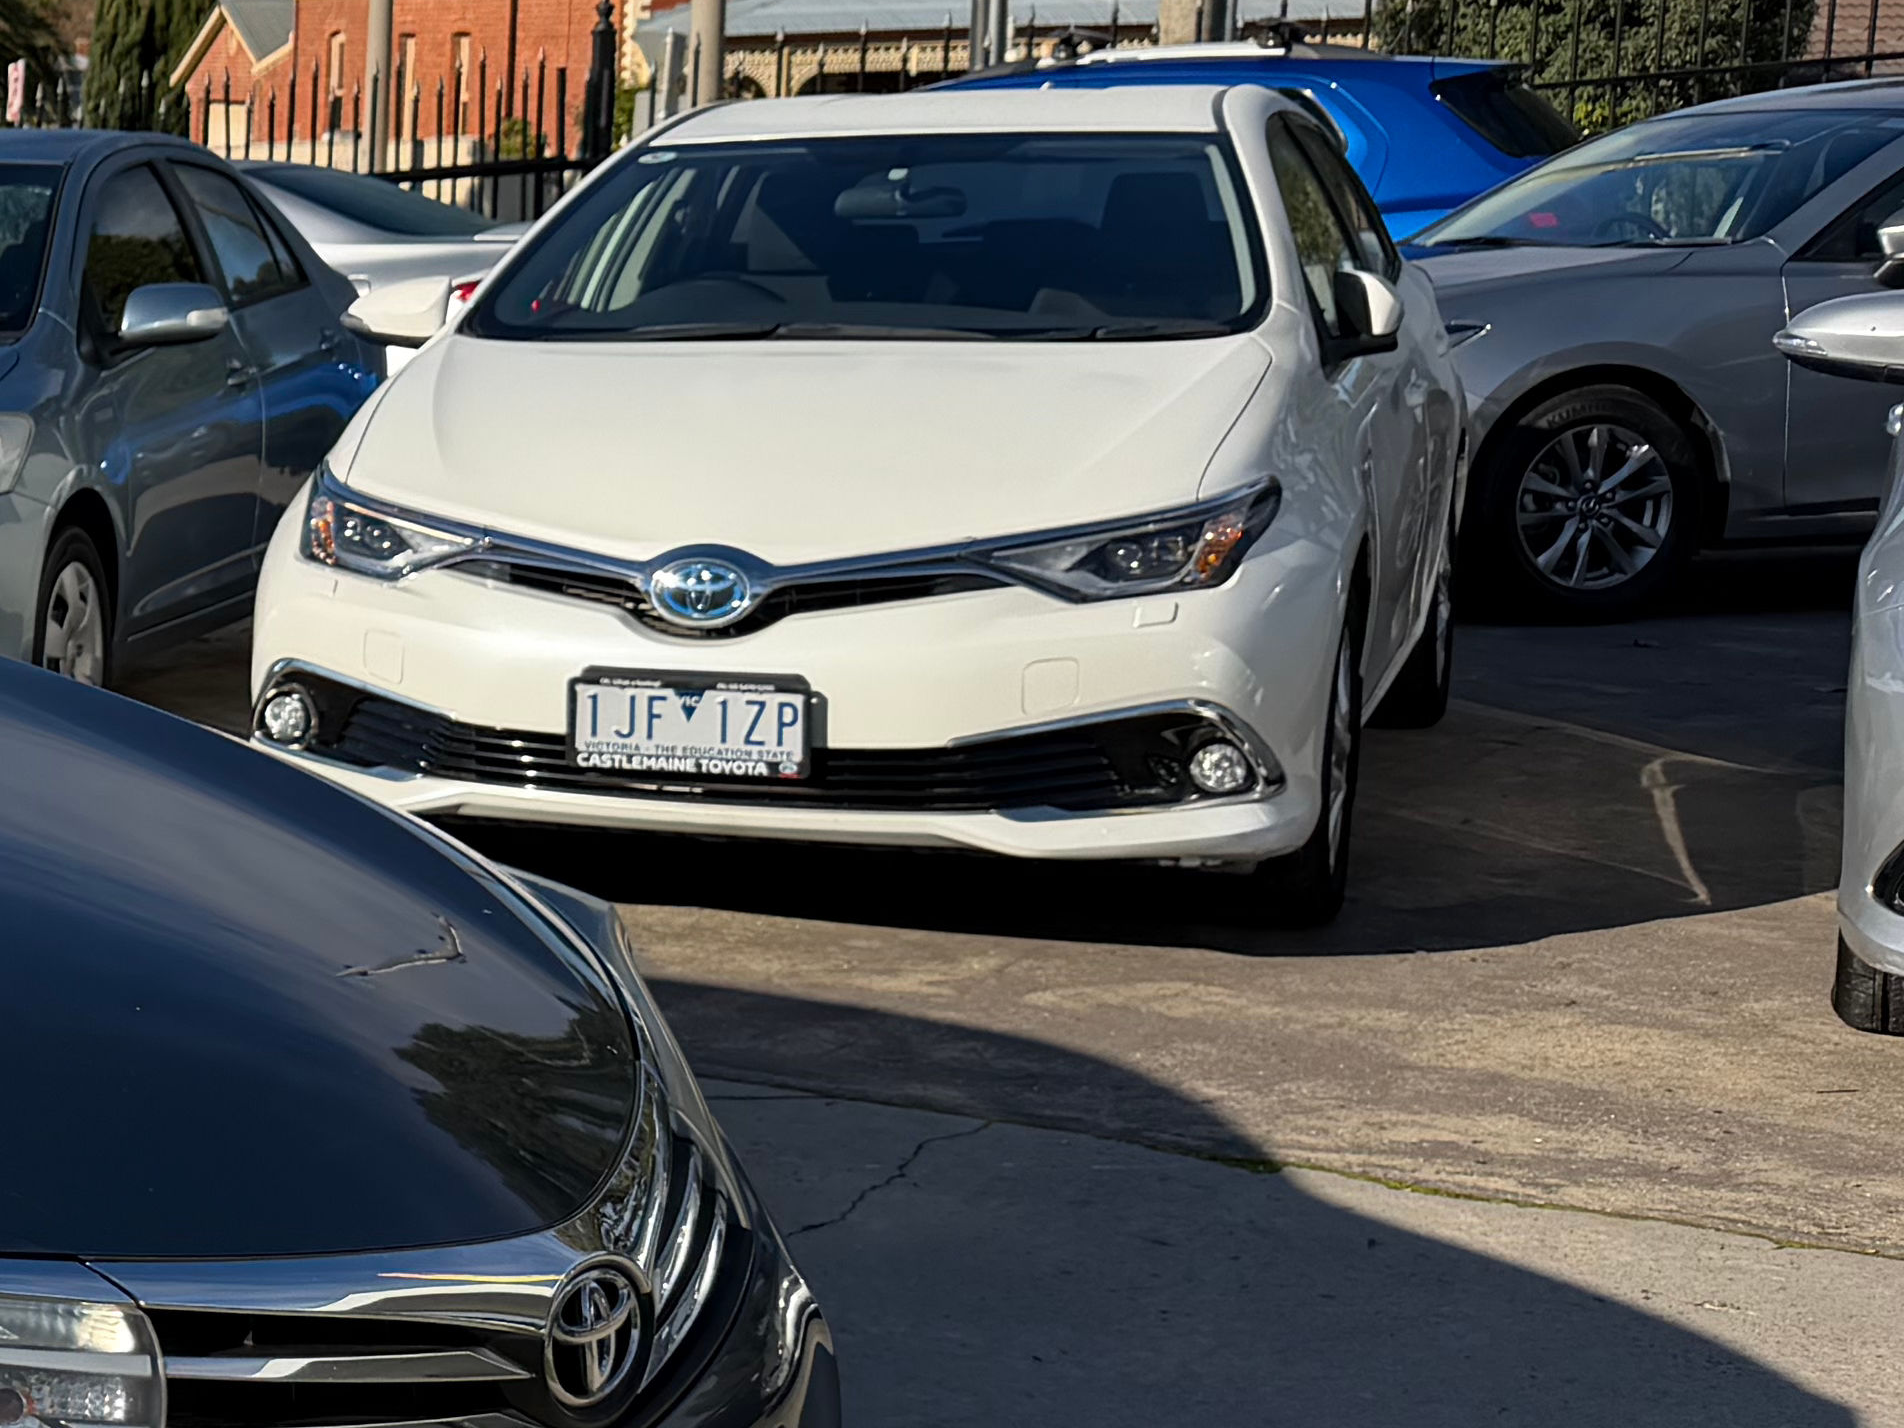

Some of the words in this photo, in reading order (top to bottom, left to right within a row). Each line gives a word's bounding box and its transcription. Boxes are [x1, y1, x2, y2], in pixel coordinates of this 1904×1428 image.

[584, 740, 641, 752] VICTORIA
[654, 744, 677, 756] THE
[682, 746, 753, 759] EDUCATION
[757, 750, 794, 761] STATE
[576, 752, 697, 773] CASTLEMAINE
[699, 758, 769, 776] TOYOTA
